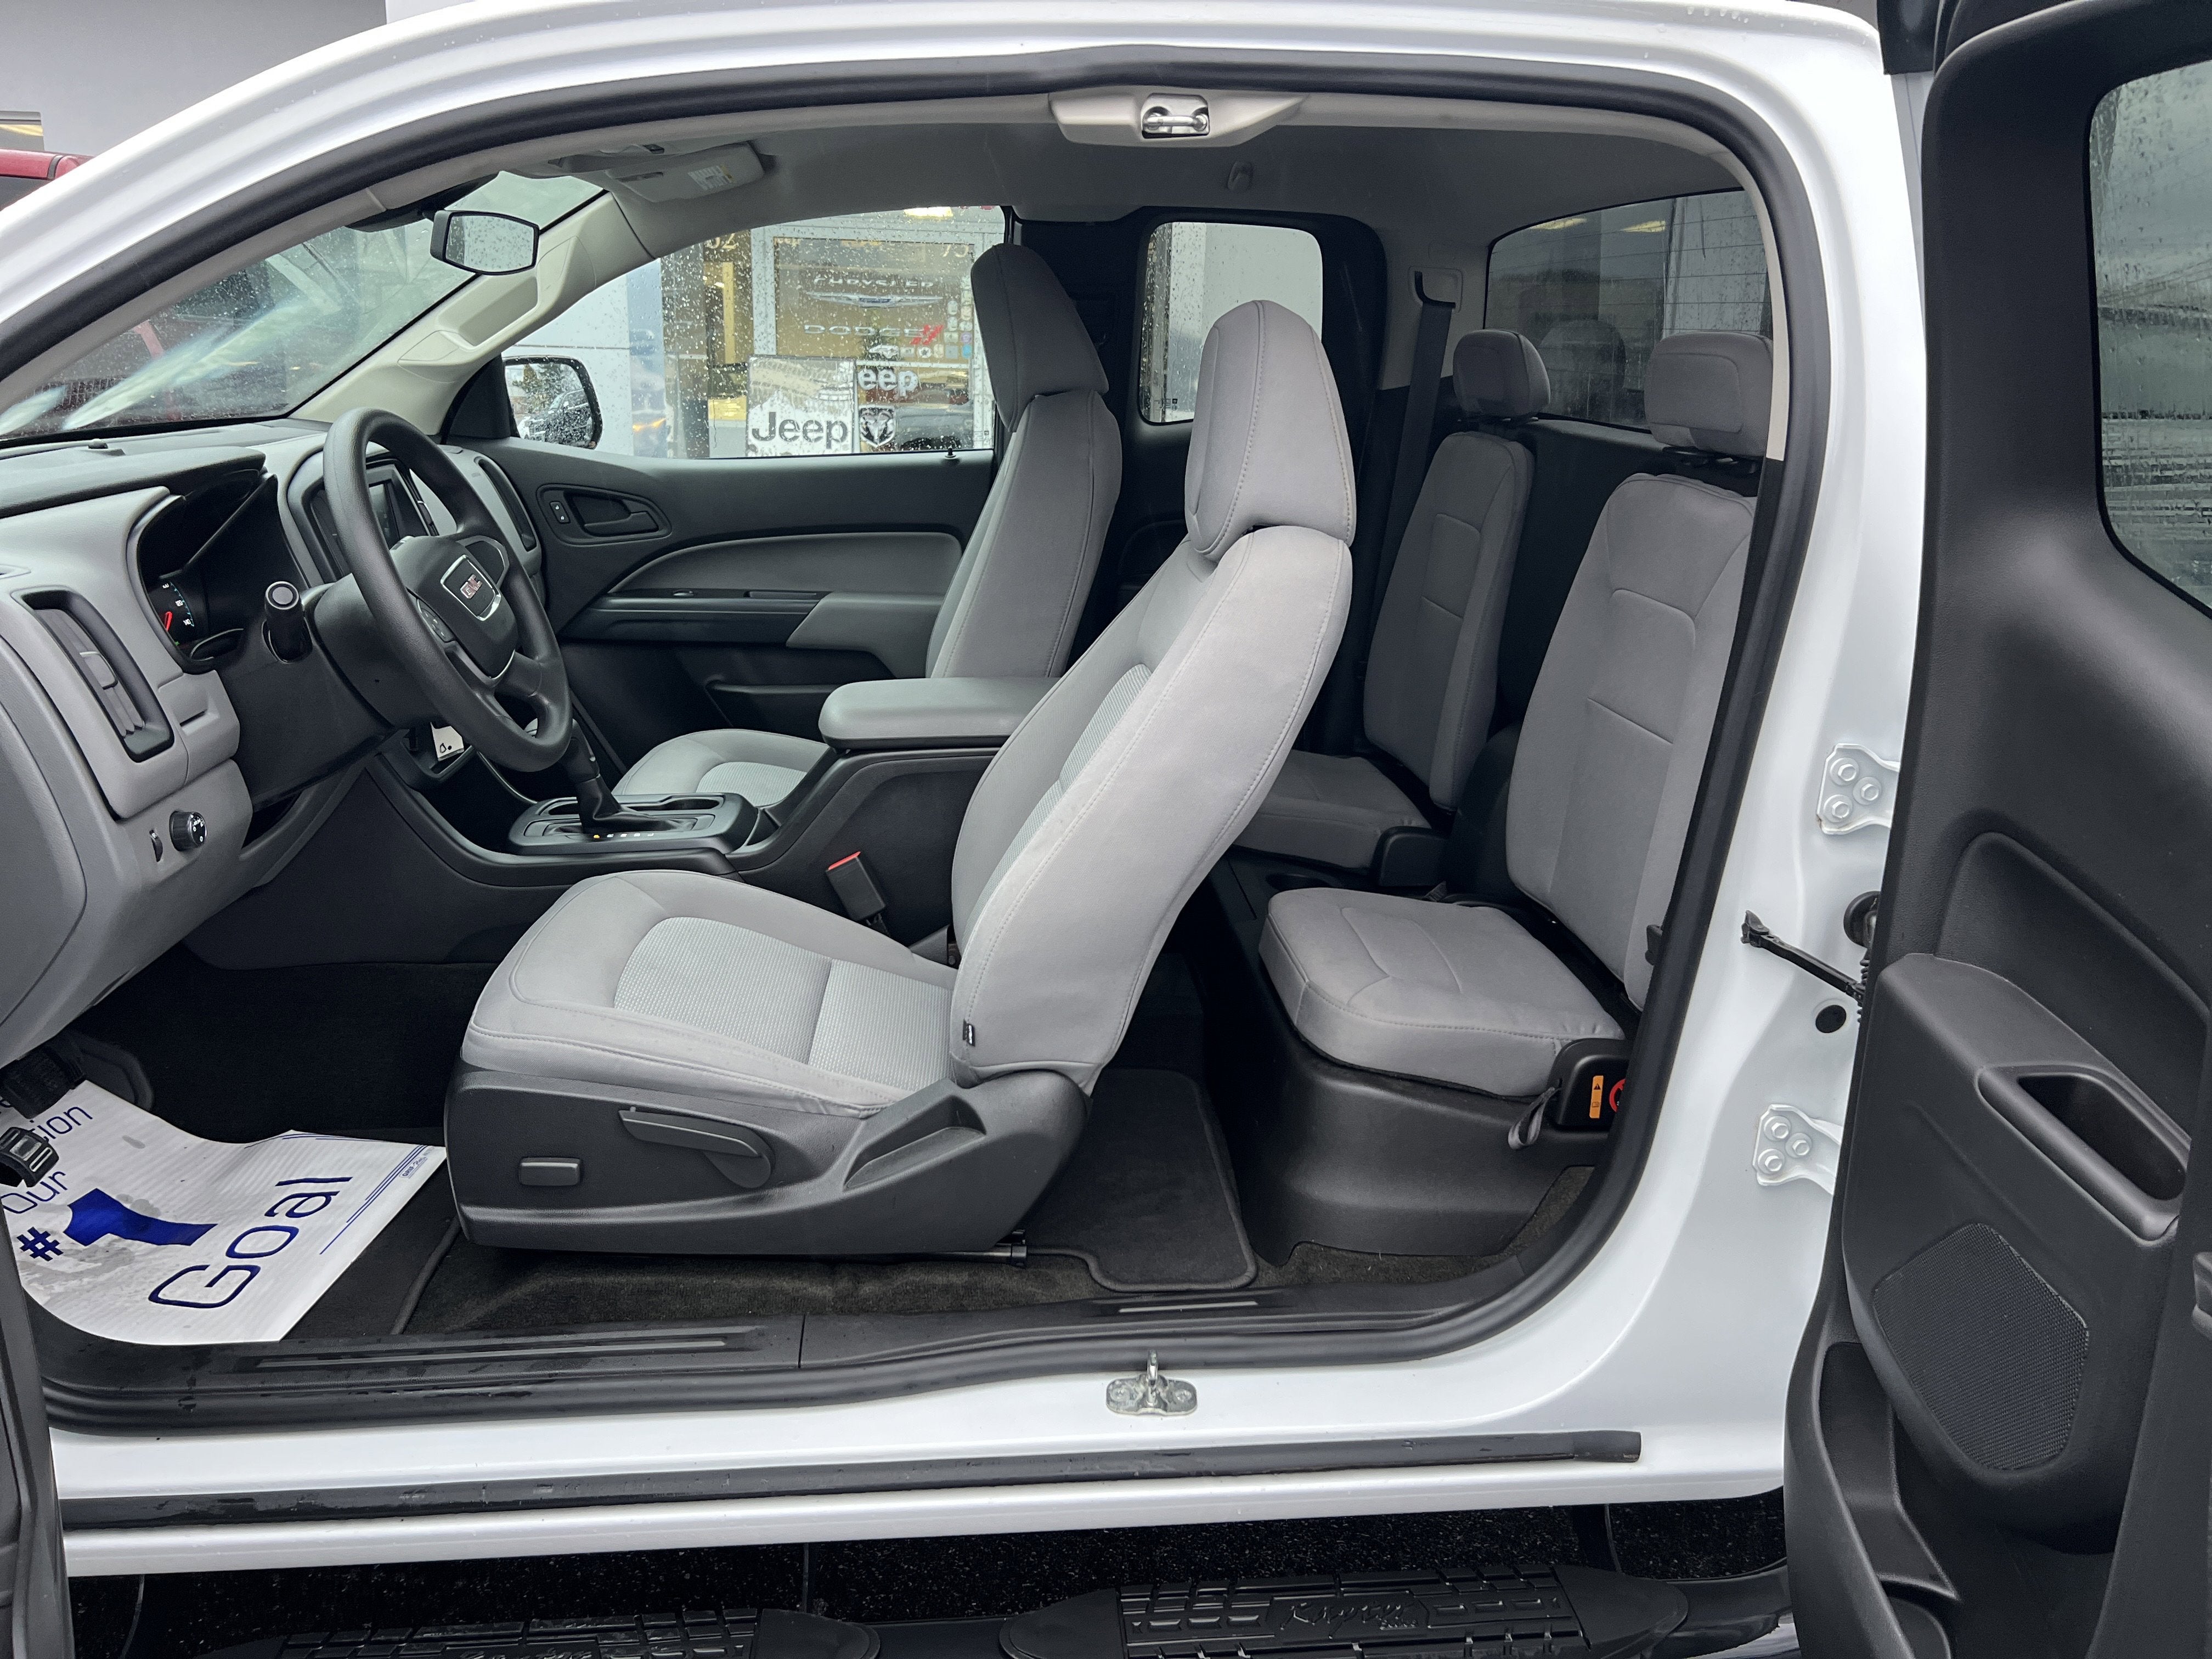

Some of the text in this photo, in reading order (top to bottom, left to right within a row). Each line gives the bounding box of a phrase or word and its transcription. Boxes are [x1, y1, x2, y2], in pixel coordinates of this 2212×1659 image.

[804, 325, 924, 337] DODGE
[857, 368, 918, 397] eep
[752, 411, 848, 449] Jeep
[0, 1171, 68, 1214] Our
[148, 1176, 353, 1309] Goal
